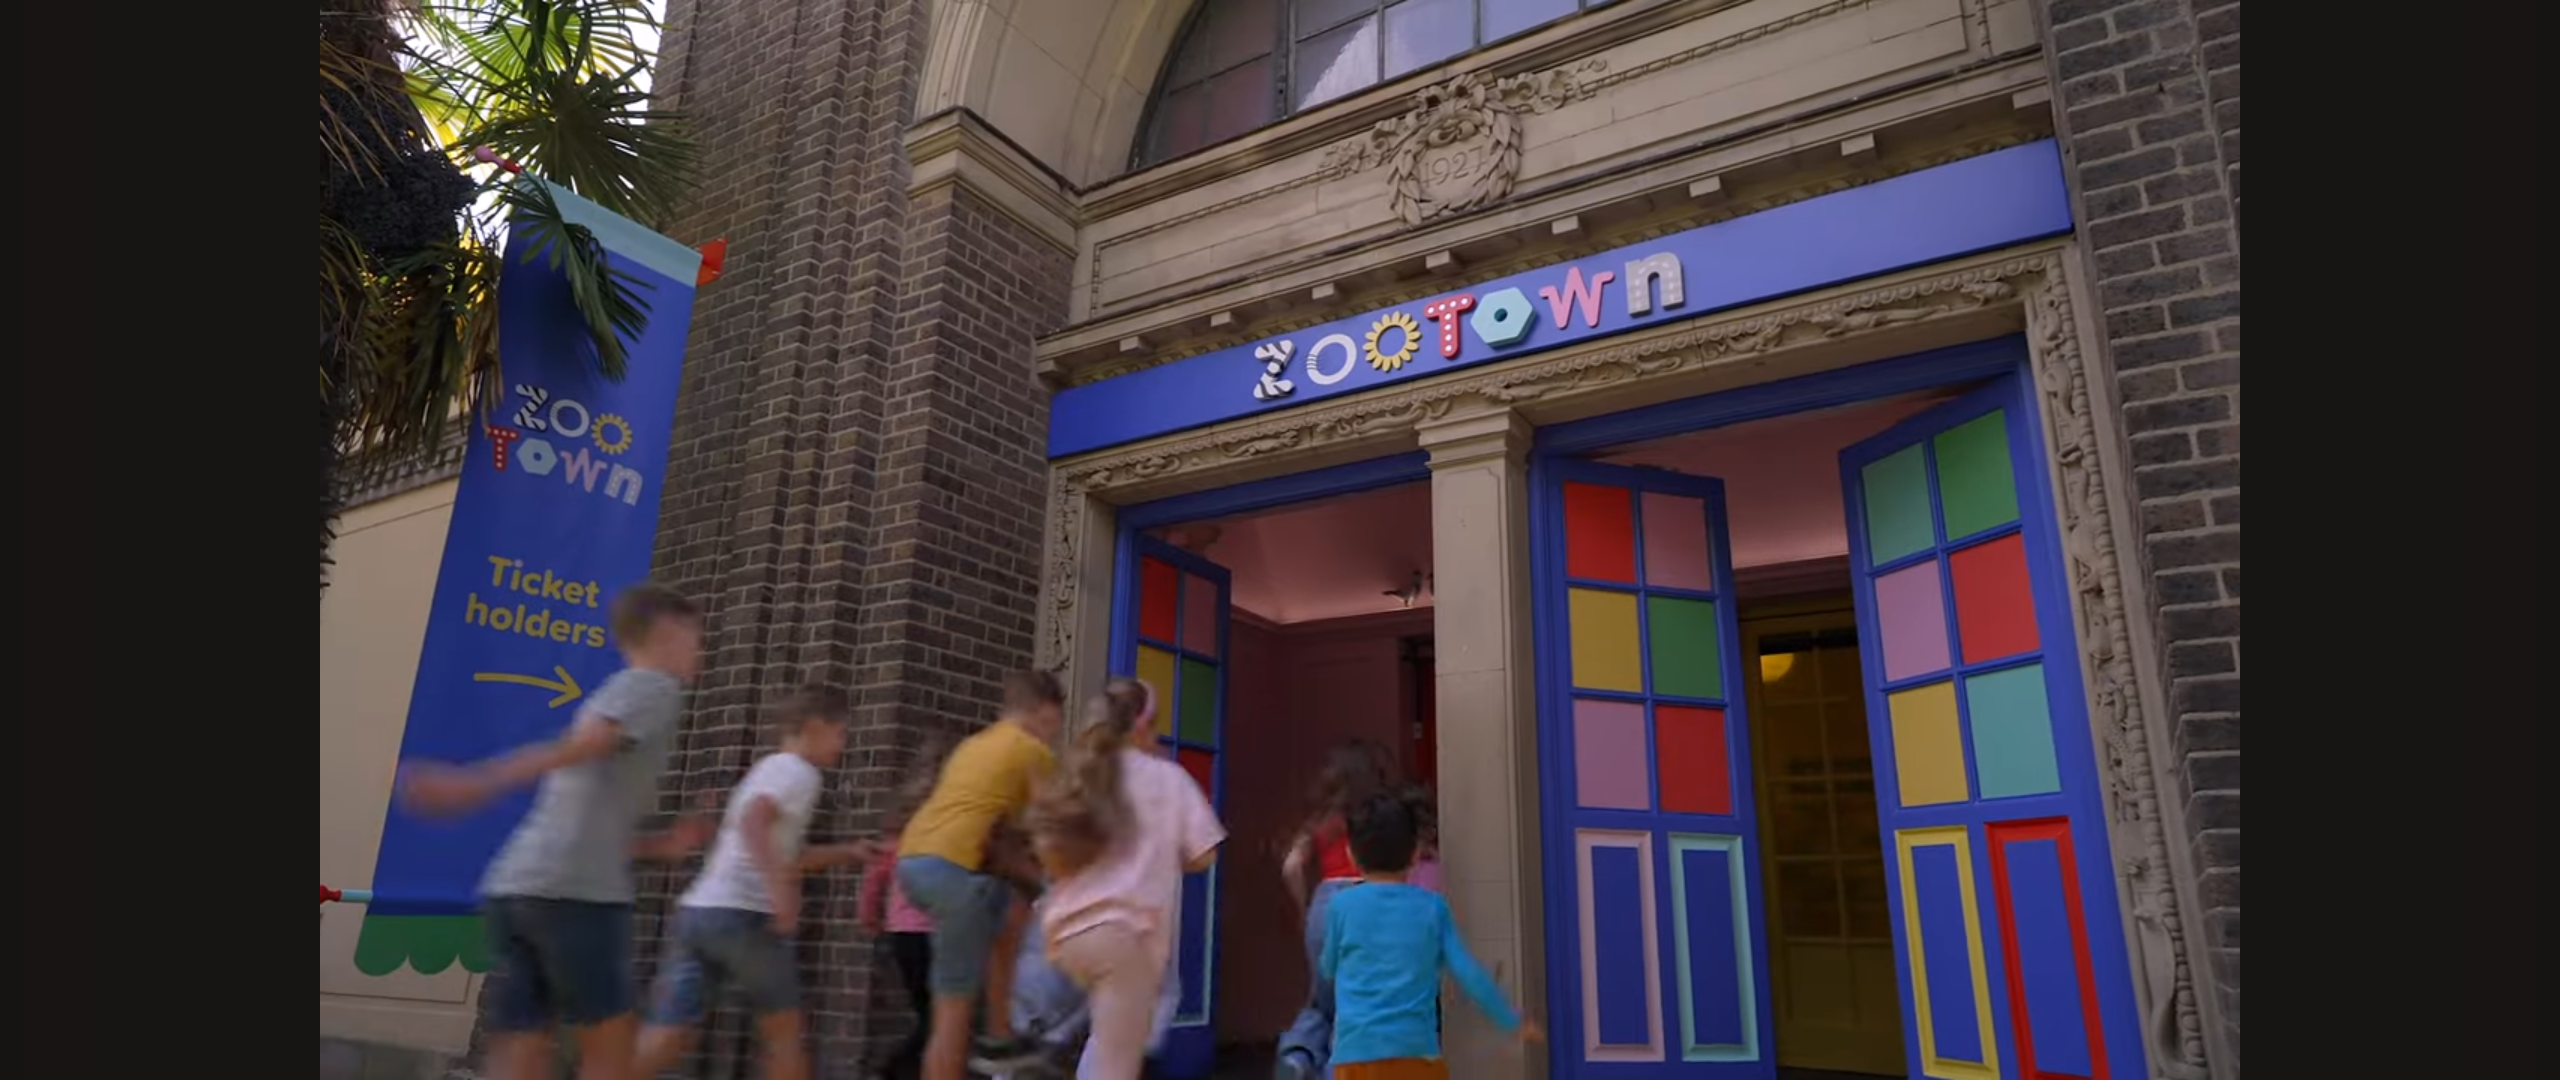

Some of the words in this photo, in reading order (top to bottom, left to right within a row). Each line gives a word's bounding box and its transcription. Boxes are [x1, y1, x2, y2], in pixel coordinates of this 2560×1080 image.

[1423, 145, 1485, 188] 1927
[512, 383, 633, 455] ZOO
[488, 555, 600, 608] Ticket
[465, 592, 606, 648] holders
